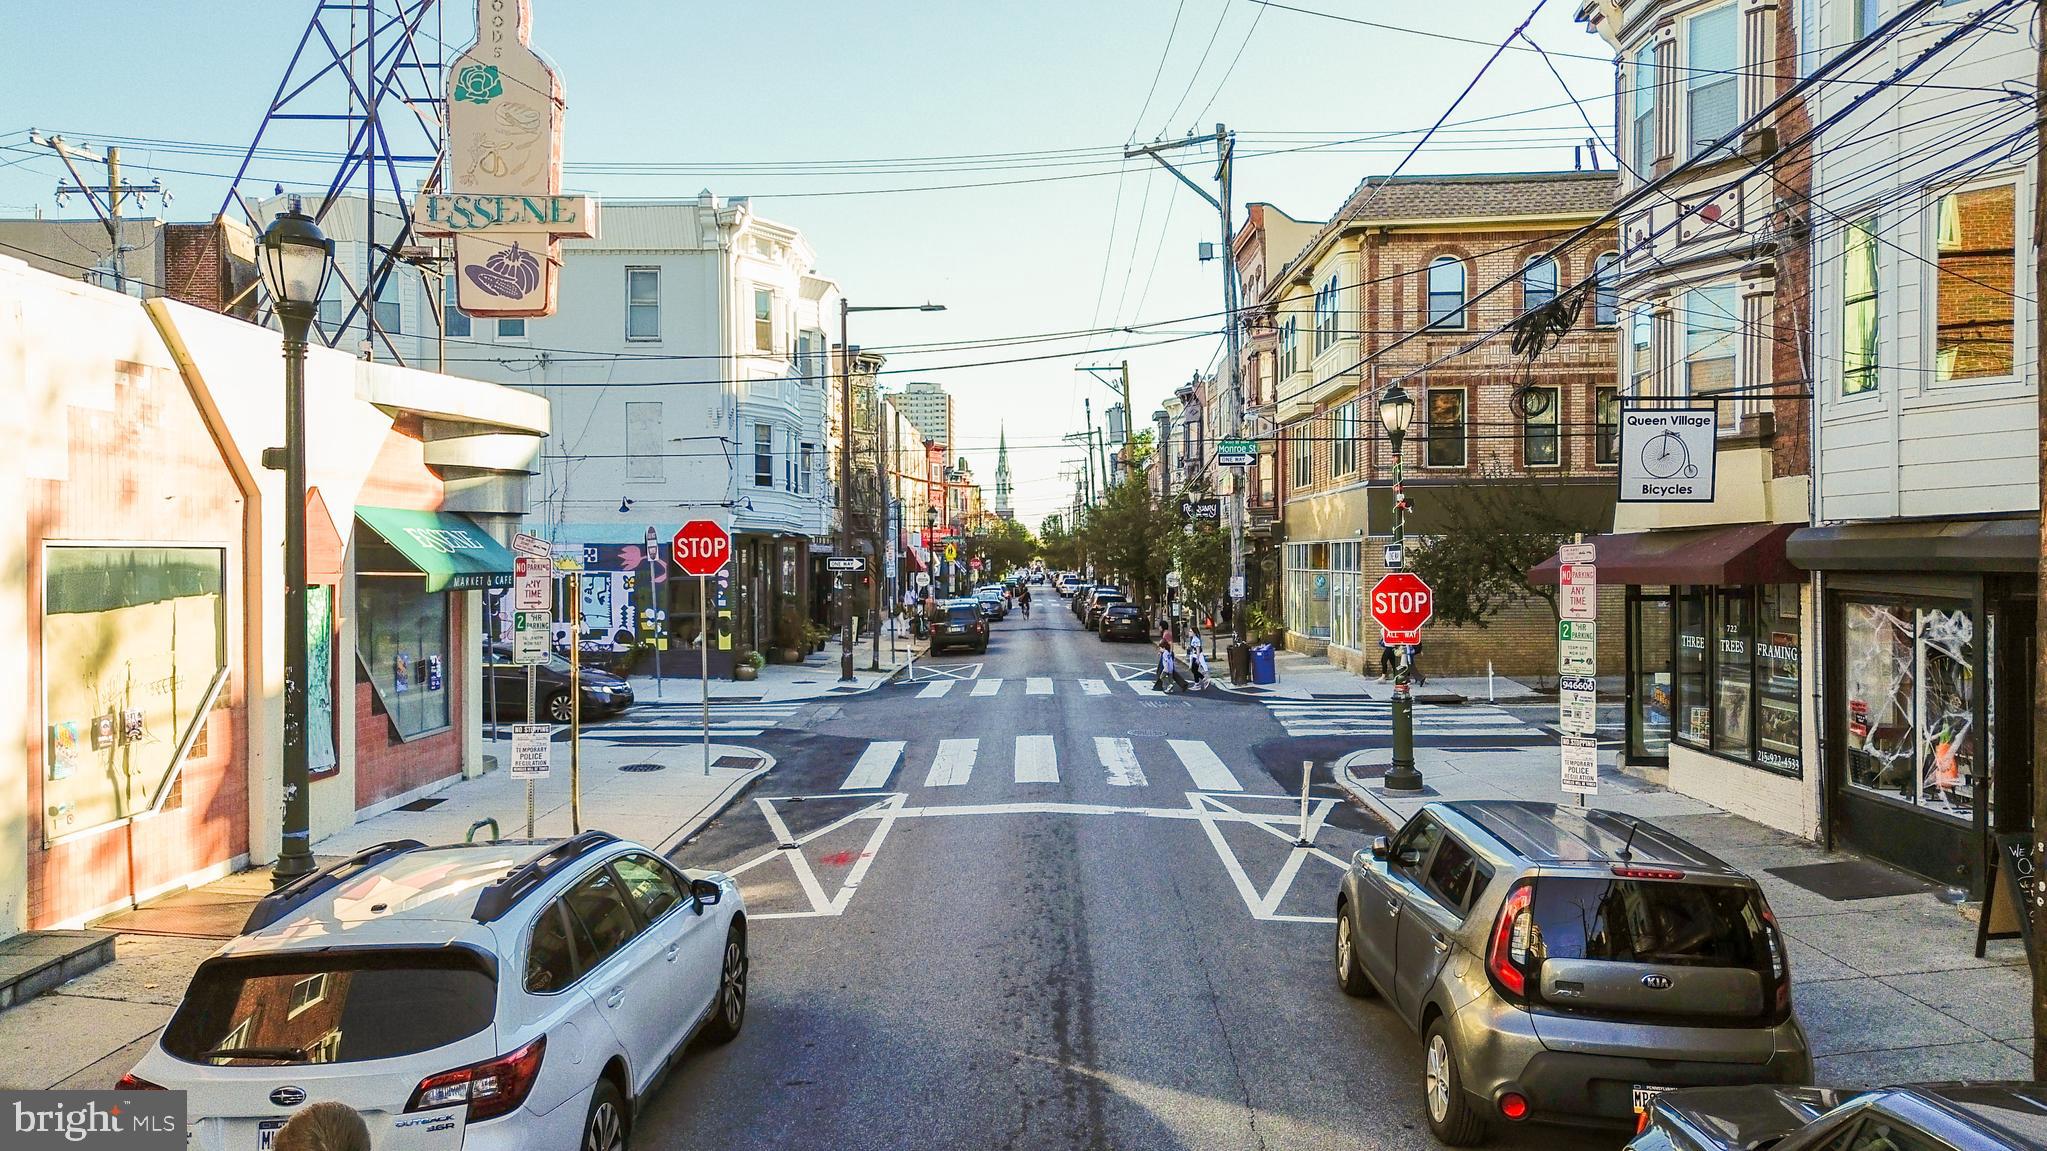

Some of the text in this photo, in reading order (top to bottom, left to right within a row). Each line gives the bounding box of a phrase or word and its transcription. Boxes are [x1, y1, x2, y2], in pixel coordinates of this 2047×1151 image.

[427, 196, 576, 230] ESSENE
[1627, 415, 1711, 428] Queen Village
[1218, 443, 1257, 453] Monroe St
[1642, 484, 1693, 496] Bicycles
[402, 527, 484, 553] ESSENE
[677, 537, 726, 558] STOP
[516, 562, 550, 573] NO PARKING
[1562, 570, 1594, 581] NO PARKING
[453, 576, 484, 587] MARKET
[486, 576, 493, 586] &
[525, 580, 541, 589] ANY
[525, 590, 542, 599] TIME
[1570, 586, 1586, 595] ANY
[1375, 592, 1427, 614] STOP
[1570, 596, 1587, 605] TIME
[517, 615, 525, 629] 2
[526, 622, 549, 630] PARKING
[1562, 623, 1587, 638] 2 HR
[1726, 624, 1738, 633] 722
[1571, 632, 1594, 640] PARKING
[1681, 635, 1798, 661] THREE TREES FRAMING
[1562, 680, 1594, 691] 946606
[1570, 740, 1594, 748] STOPPING
[1757, 750, 1800, 771] 215-922-4533
[2008, 843, 2026, 858] WE
[1647, 977, 1669, 988] KIA
[395, 1114, 455, 1128] OUTBACK
